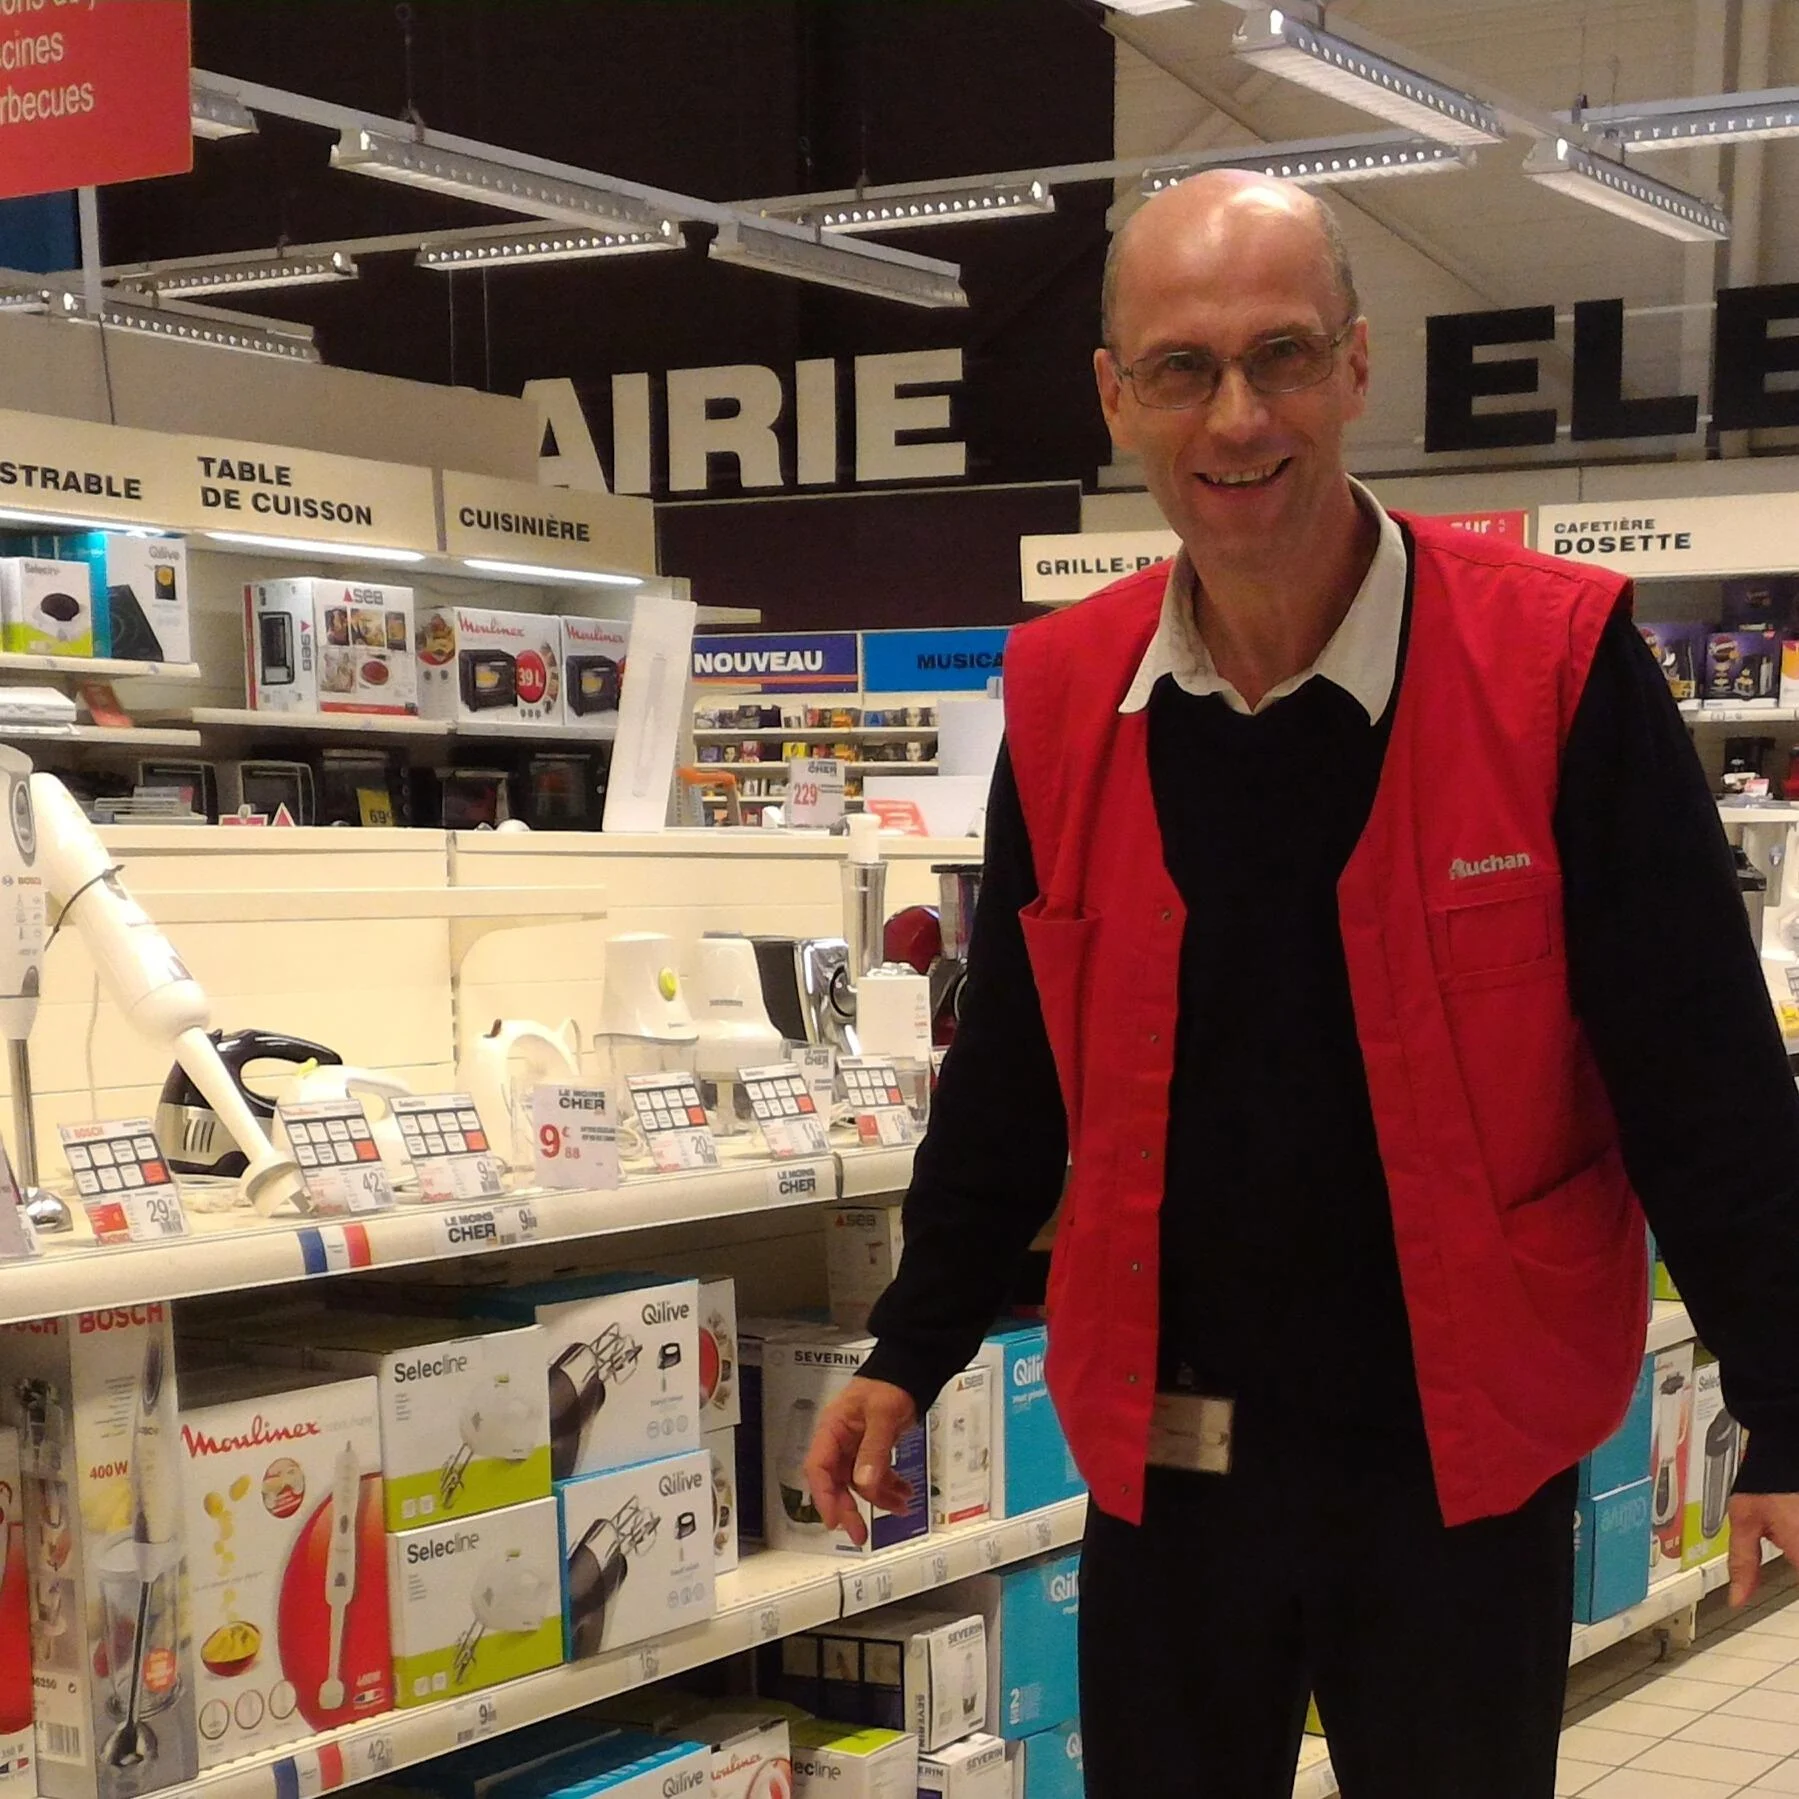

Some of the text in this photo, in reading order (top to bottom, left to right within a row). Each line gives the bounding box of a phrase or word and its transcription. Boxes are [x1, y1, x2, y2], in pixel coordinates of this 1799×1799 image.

[1425, 283, 1799, 453] ELE
[521, 348, 967, 495] AIRIE
[0, 461, 142, 500] STRABLE
[198, 456, 292, 487] TABLE
[201, 486, 373, 526] DE CUISSON
[458, 507, 591, 543] CUISINIÈRE
[1553, 517, 1656, 535] CAFETIÈRE
[1553, 532, 1692, 556] DOSETTE
[694, 650, 824, 674] NOUVEAU
[518, 667, 533, 687] 39
[1448, 853, 1531, 880] Auchan
[558, 1097, 605, 1110] CHER
[779, 1178, 816, 1195] CHER
[448, 1223, 497, 1244] CHER
[78, 1302, 164, 1334] BOSCH
[641, 1301, 690, 1326] Qilive
[393, 1353, 468, 1384] Selecline
[794, 1350, 860, 1366] SEVERIN
[181, 1414, 321, 1458] Moulinex
[658, 1471, 703, 1497] Qilive
[406, 1531, 481, 1564] Selecline
[947, 1623, 983, 1644] SEVERIN
[966, 1746, 1003, 1771] SEVERIN
[662, 1769, 704, 1799] Qilive
